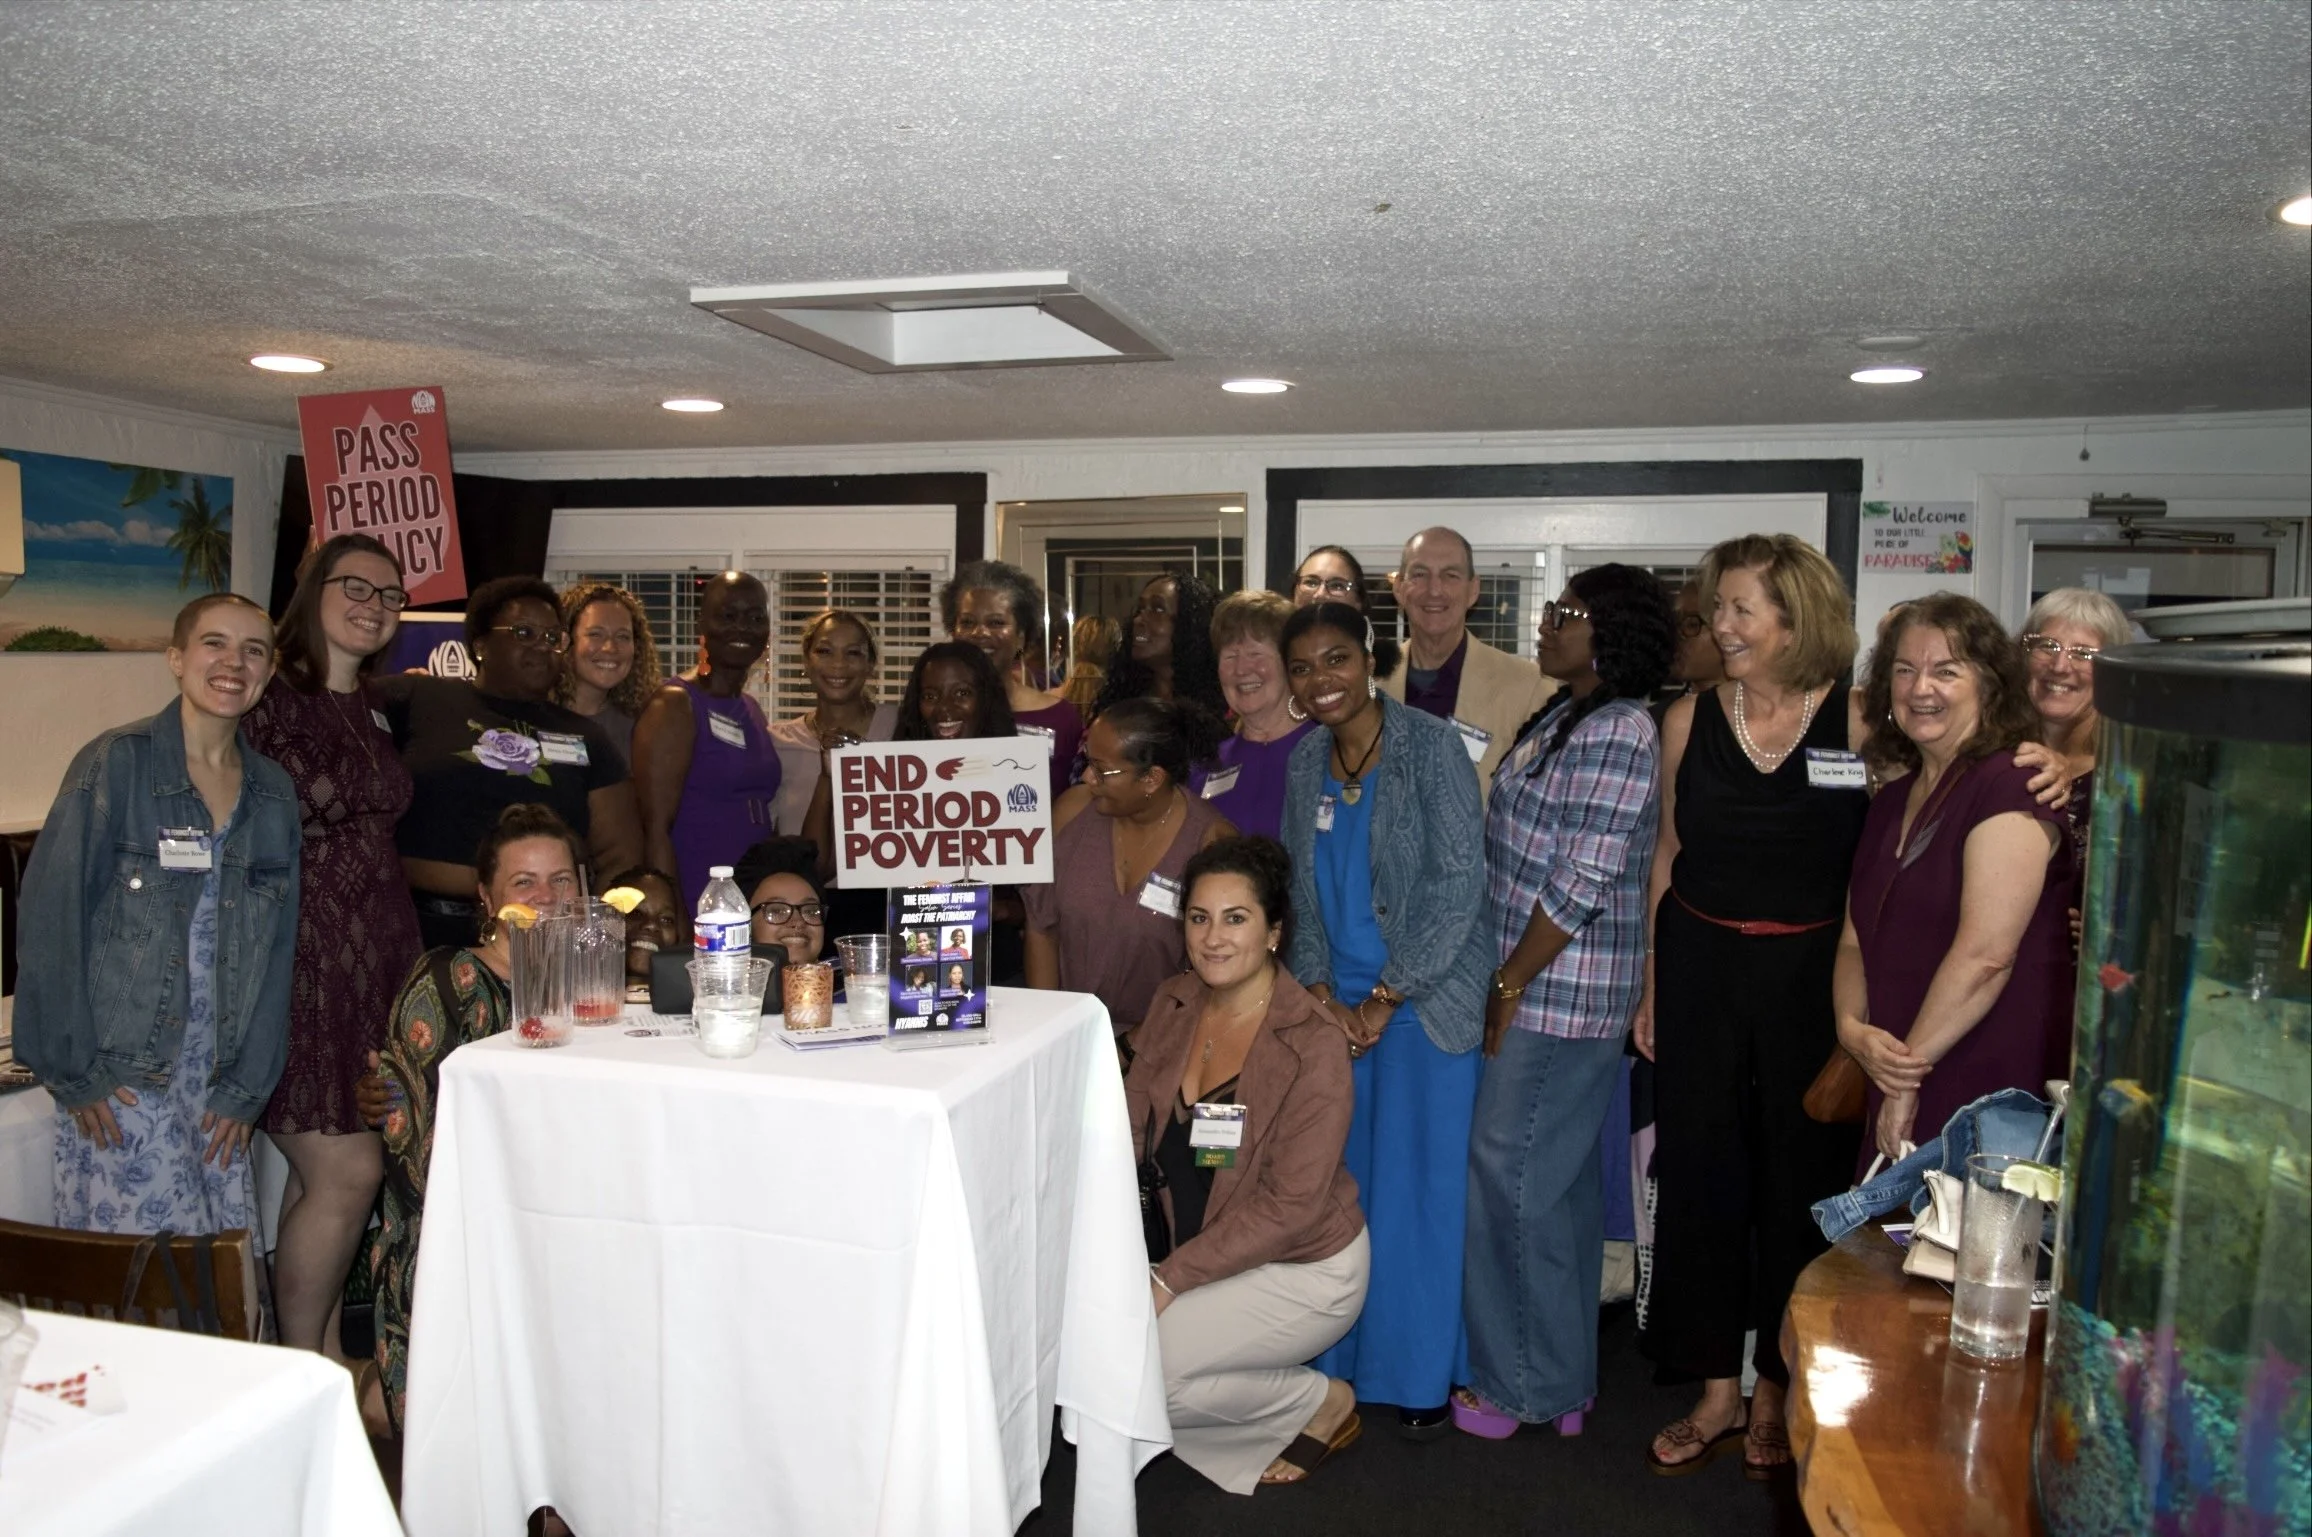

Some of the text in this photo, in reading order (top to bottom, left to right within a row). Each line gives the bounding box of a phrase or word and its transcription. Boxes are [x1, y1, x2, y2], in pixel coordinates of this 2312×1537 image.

[413, 406, 436, 415] MASS
[333, 420, 420, 475] PASS
[324, 474, 442, 532] PERIOD
[1893, 506, 1966, 523] Welcome
[1874, 529, 1883, 537] TO
[1886, 528, 1902, 537] OUR
[377, 524, 444, 576] ICY
[1898, 540, 1909, 548] OF
[1864, 554, 1933, 569] PARADISE
[840, 755, 928, 793] END
[1813, 767, 1845, 776] Charlene
[842, 791, 1001, 831] PERIOD
[844, 828, 1046, 870] POVERTY
[903, 892, 976, 906] THE FEMINIST AFFAIR
[923, 912, 936, 922] THE
[936, 910, 977, 922] PATRIARCHY
[895, 1016, 929, 1030] HYANNIS
